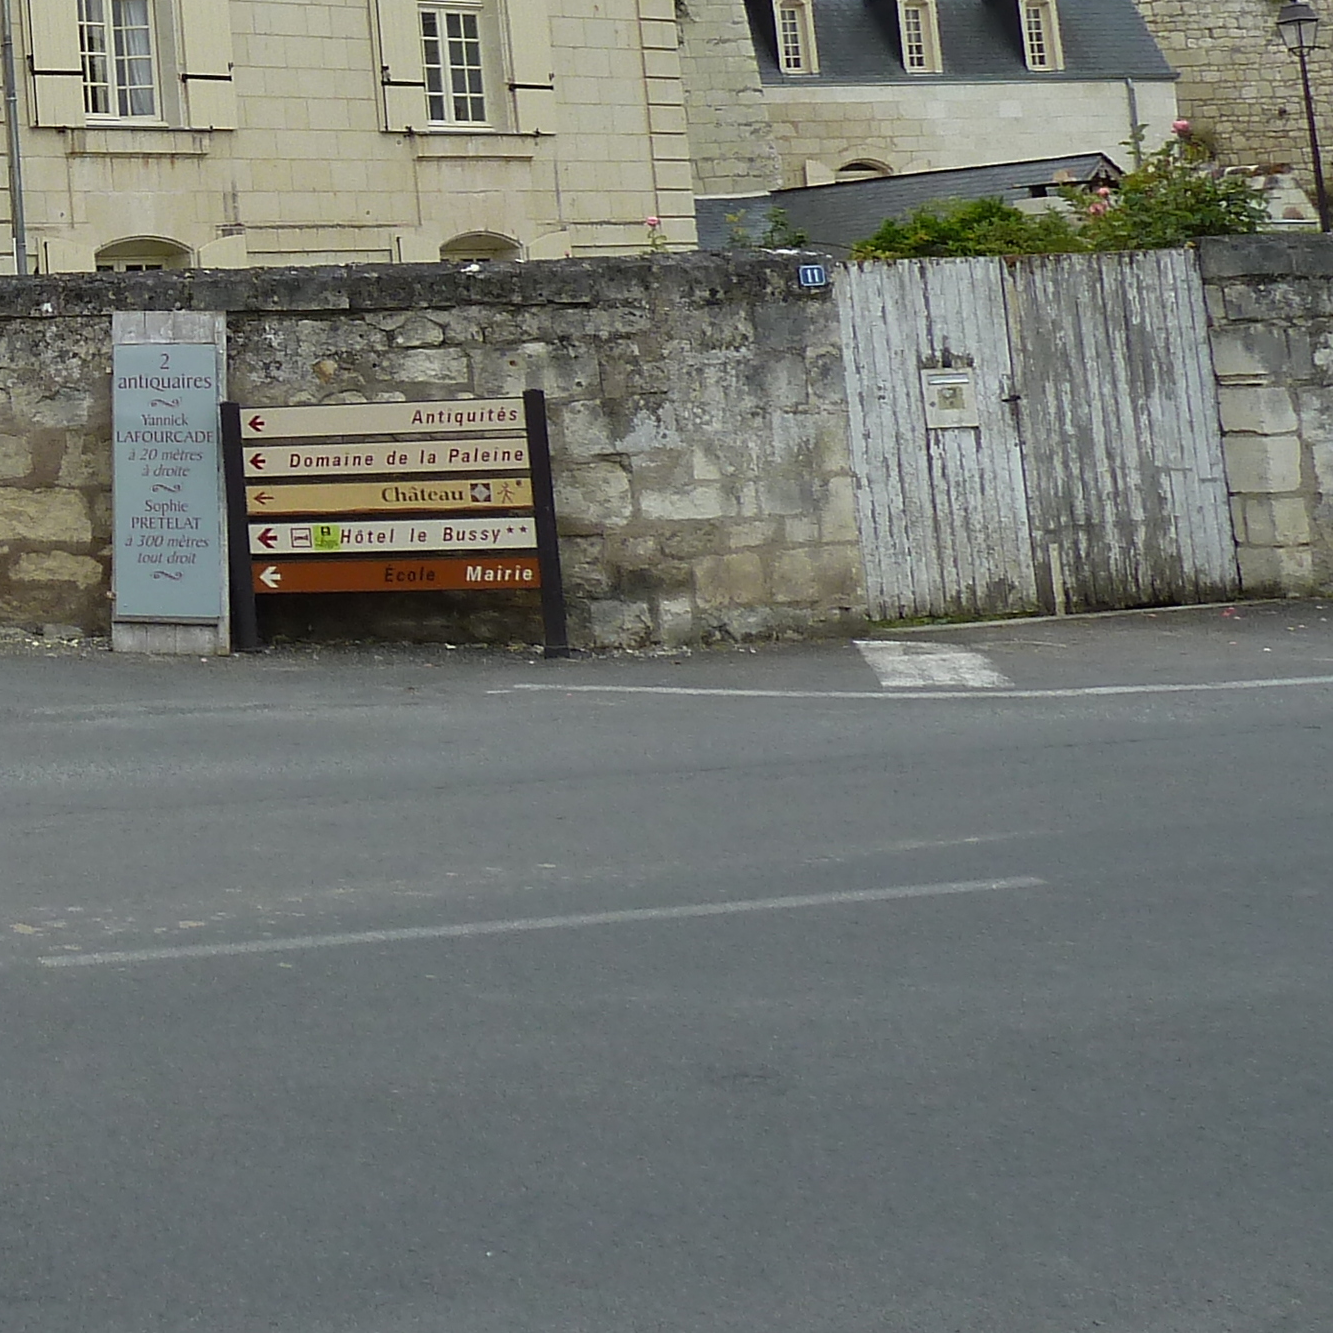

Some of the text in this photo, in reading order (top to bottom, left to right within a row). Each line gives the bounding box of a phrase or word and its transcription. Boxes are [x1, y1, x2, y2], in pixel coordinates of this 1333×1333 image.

[806, 268, 819, 283] 11
[160, 353, 170, 370] 2
[118, 373, 212, 392] antiquaires
[141, 413, 188, 426] Yannick
[411, 407, 518, 426] Antiquités
[116, 430, 214, 444] LAFOURCADE
[139, 448, 158, 461] 20
[161, 448, 203, 461] mètres
[290, 447, 524, 468] Domaine de la Paleine
[153, 464, 190, 477] droite
[382, 487, 464, 503] Château
[145, 499, 189, 516] Sophie
[131, 517, 201, 530] PRETELAT
[137, 535, 164, 547] 300
[167, 534, 209, 548] mètres
[340, 528, 395, 544] Hôtel
[410, 527, 428, 542] le
[442, 526, 501, 544] Bussy
[137, 551, 196, 564] tout droit
[384, 563, 534, 583] École Mairie
